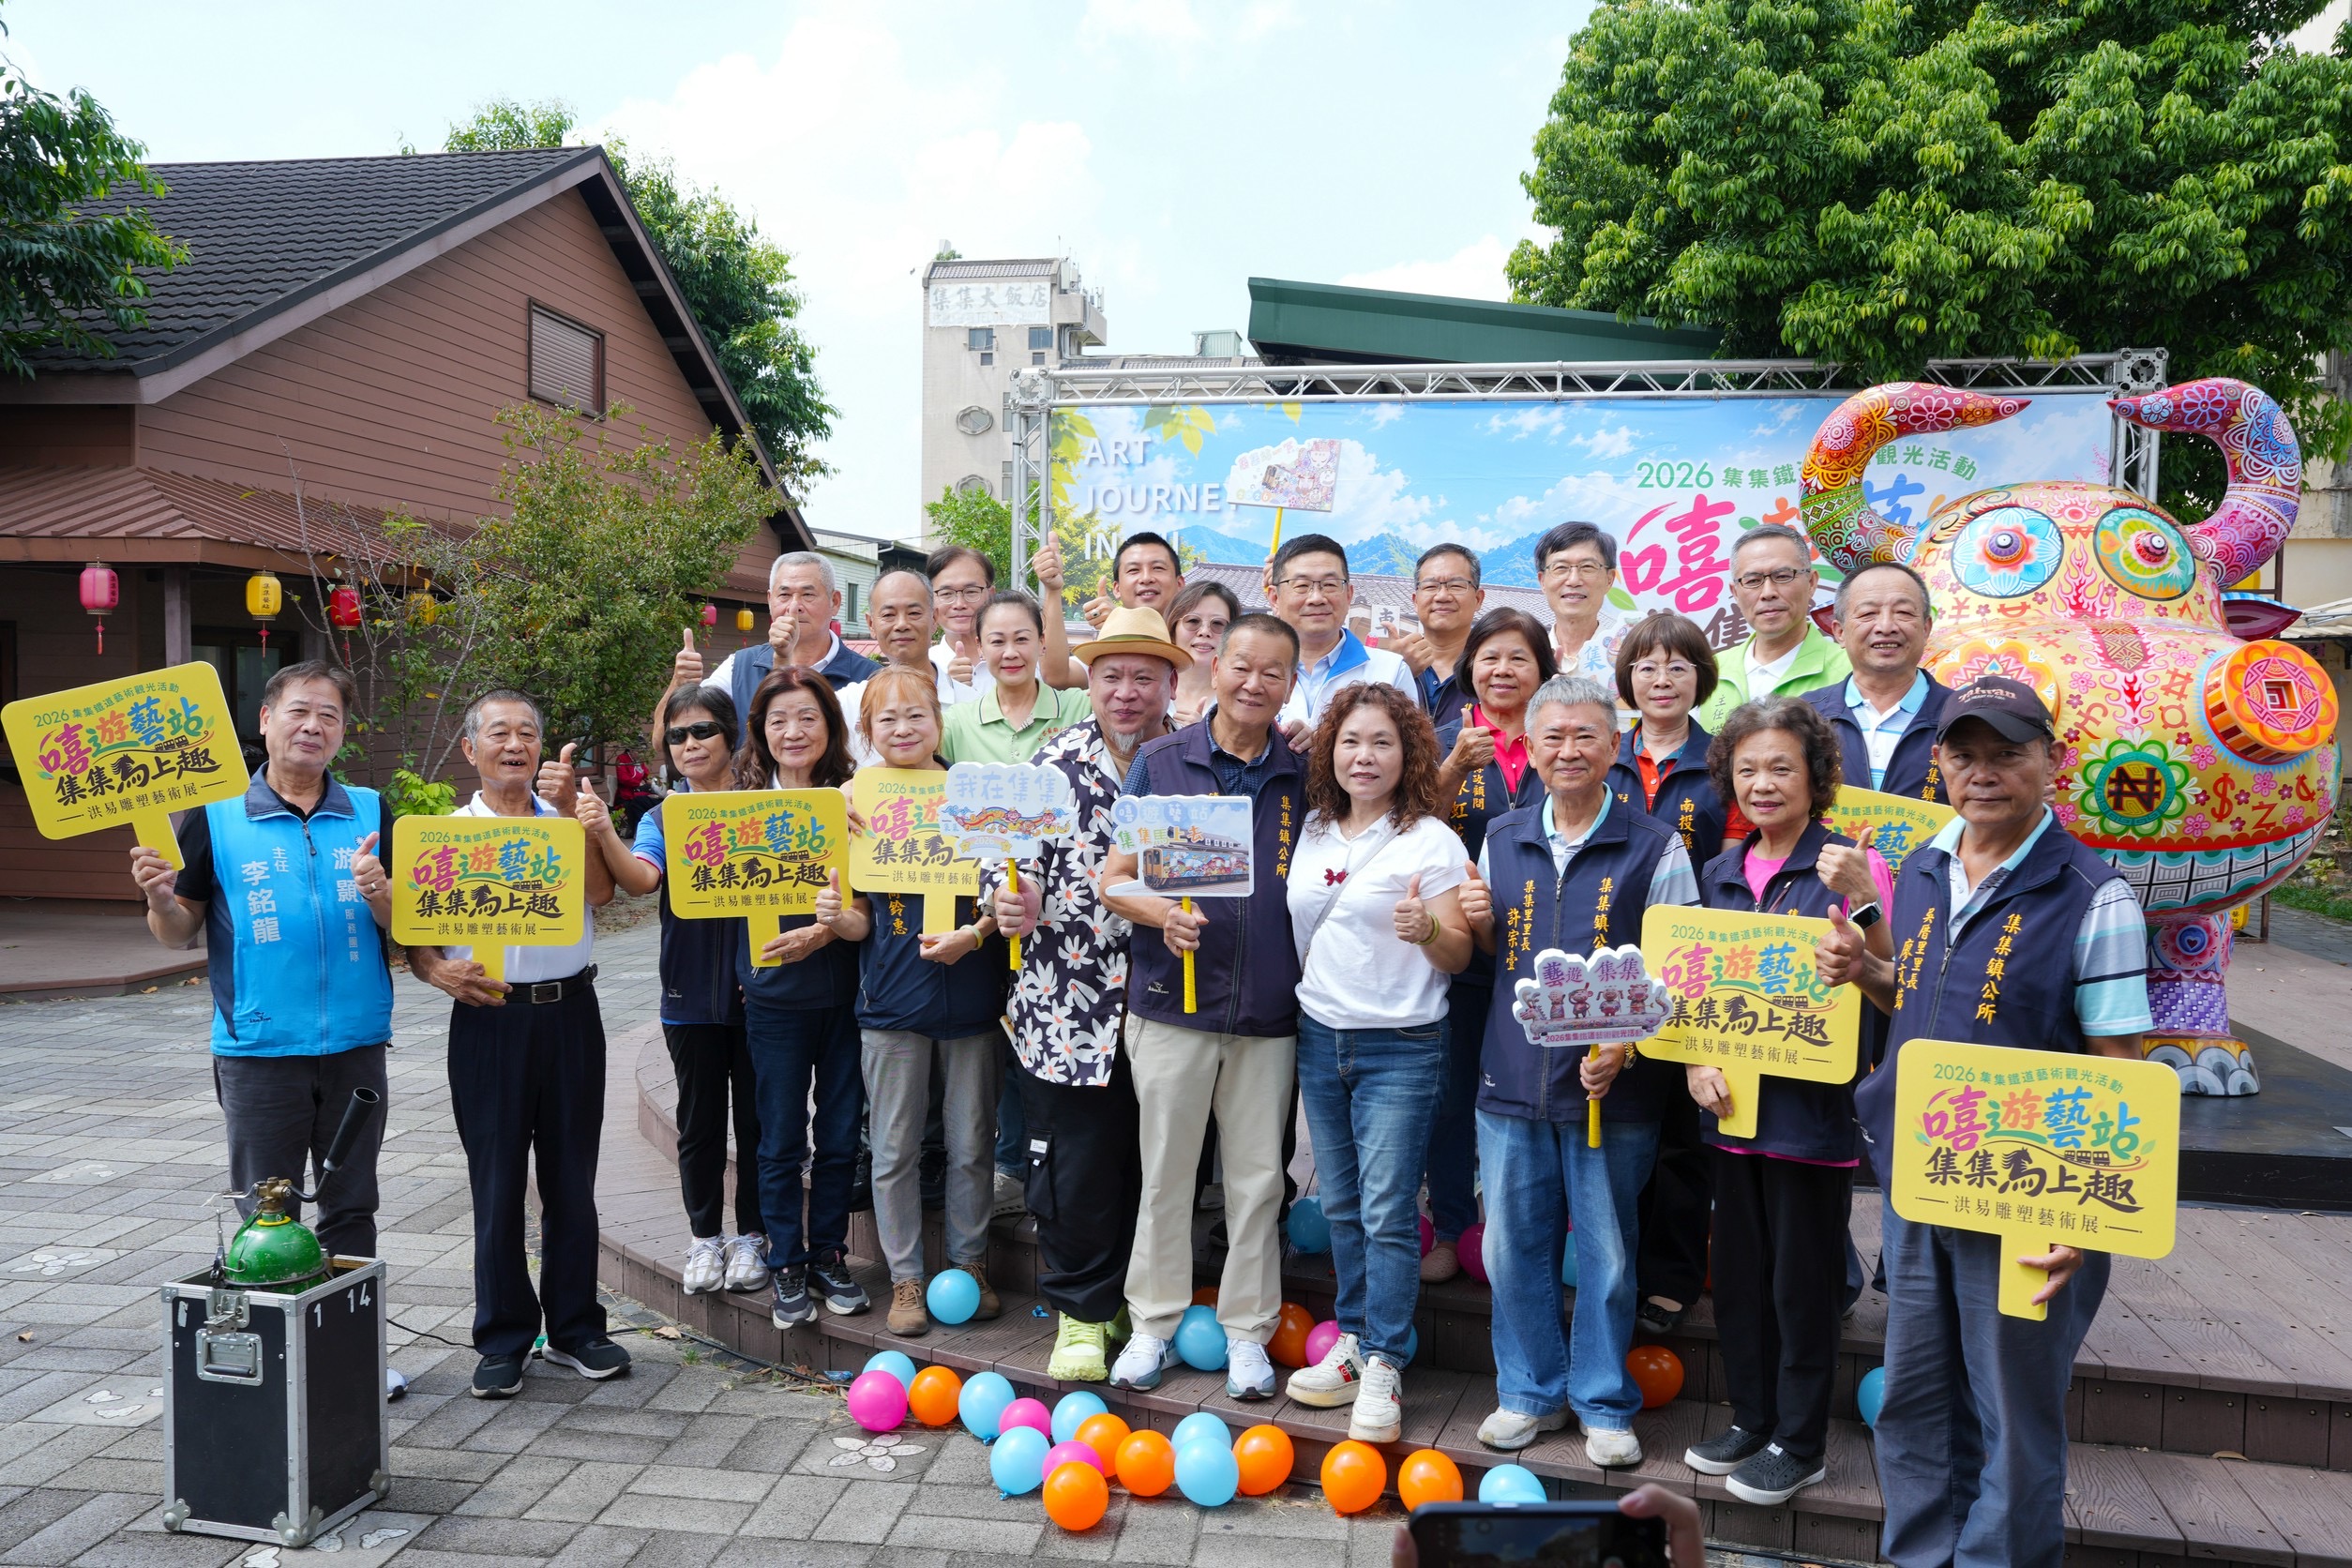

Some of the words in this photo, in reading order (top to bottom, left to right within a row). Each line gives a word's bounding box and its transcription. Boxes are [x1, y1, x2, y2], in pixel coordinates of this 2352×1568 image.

[933, 285, 1048, 310] 集集大飯店
[1085, 436, 1152, 465] ART
[1636, 462, 1714, 489] 2026
[1085, 532, 1118, 560] IN
[34, 710, 69, 728] 2026
[38, 696, 204, 775] 嘻遊藝站
[55, 747, 223, 807] 集集馬上趣
[878, 782, 907, 794] 2026
[955, 771, 1056, 803] 我在集集
[87, 782, 198, 820] 洪易雕塑藝術展
[687, 807, 717, 820] 2026
[420, 831, 450, 843] 2026
[685, 810, 825, 867] 嘻遊藝站
[1118, 825, 1203, 849] 集集馬上去
[1276, 795, 1291, 879] 集集鎮公所
[1679, 797, 1696, 857] 南投縣
[272, 847, 290, 873] 主任
[413, 837, 561, 893] 嘻遊藝站
[872, 835, 982, 868] 集集馬
[691, 856, 830, 892] 集集馬上趣
[241, 860, 281, 945] 李銘龍
[415, 883, 565, 919] 集集馬上趣
[714, 892, 807, 908] 洪易雕塑藝術展
[1521, 880, 1535, 951] 集集里里長
[344, 909, 360, 962] 服務團隊
[438, 923, 536, 936] 洪易雕塑藝術展
[1670, 925, 1704, 941] 2026
[1907, 907, 1936, 990] 吳厝里里長
[1543, 962, 1584, 987] 藝遊
[1594, 958, 1639, 982] 集集
[1976, 913, 2022, 1026] 集集鎮公所
[1685, 1036, 1798, 1064] 洪易雕塑藝術展
[1933, 1063, 1976, 1082] 2026
[1922, 1084, 2140, 1161] 嘻遊藝站
[1924, 1146, 2145, 1213] 集集馬上趣
[1953, 1195, 2099, 1234] 洪易雕塑藝術展
